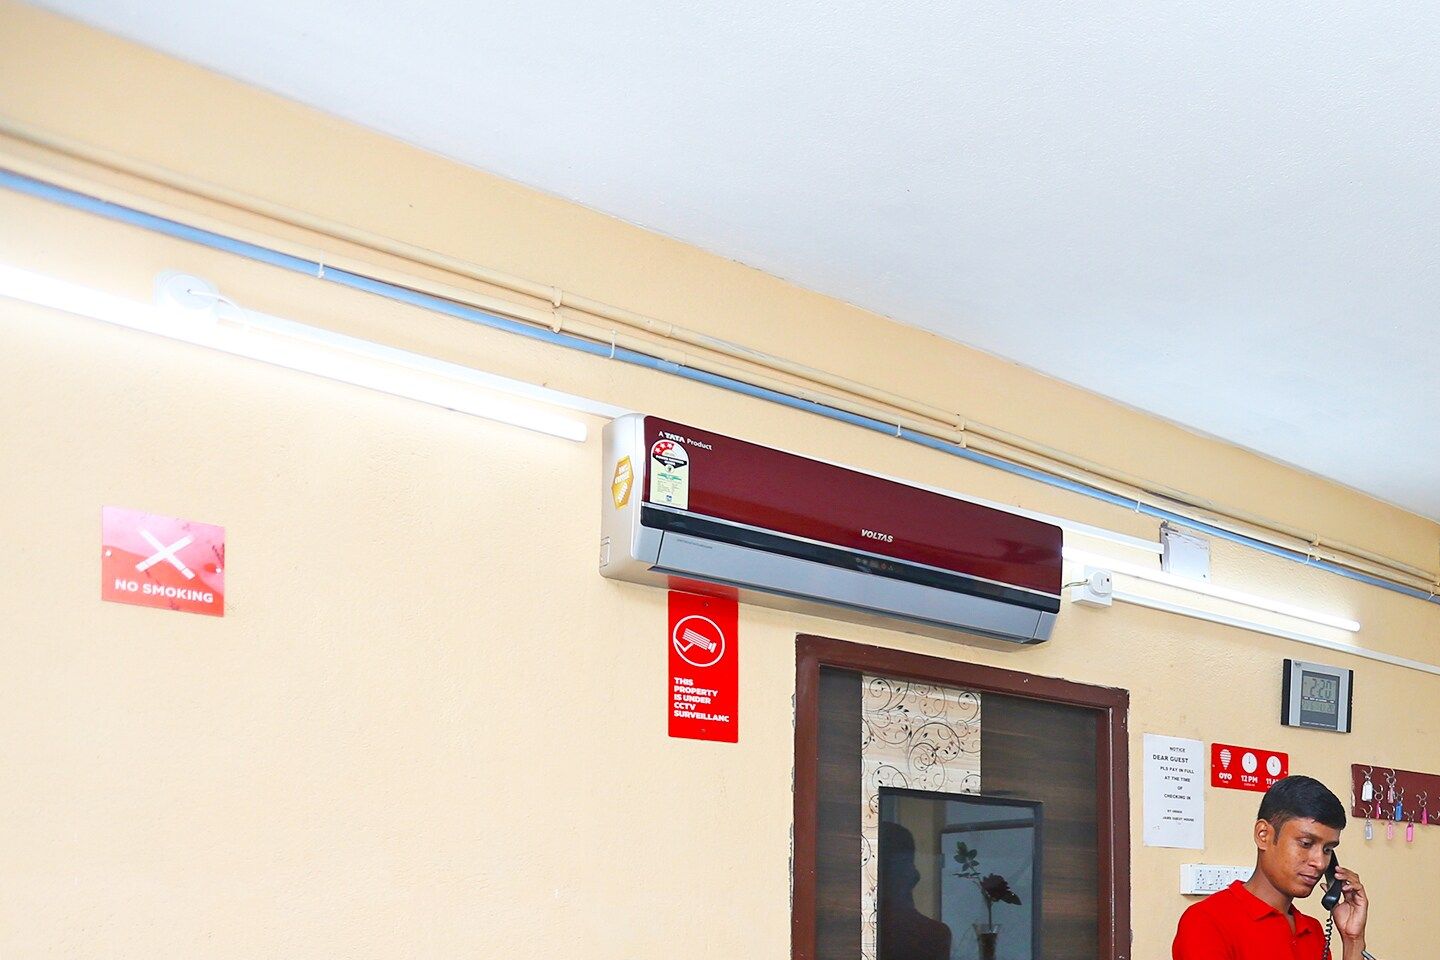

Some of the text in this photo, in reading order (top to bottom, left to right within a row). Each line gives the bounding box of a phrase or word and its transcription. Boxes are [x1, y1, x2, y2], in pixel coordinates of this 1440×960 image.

[664, 432, 685, 443] TATA
[686, 438, 712, 450] Product
[861, 529, 893, 543] VOLTAS
[114, 578, 214, 603] NO SMOKING
[673, 677, 693, 686] THIS
[673, 685, 718, 697] PROPERTY
[683, 695, 711, 704] UNDER
[673, 702, 696, 710] CCTV
[1218, 772, 1232, 780] OYO
